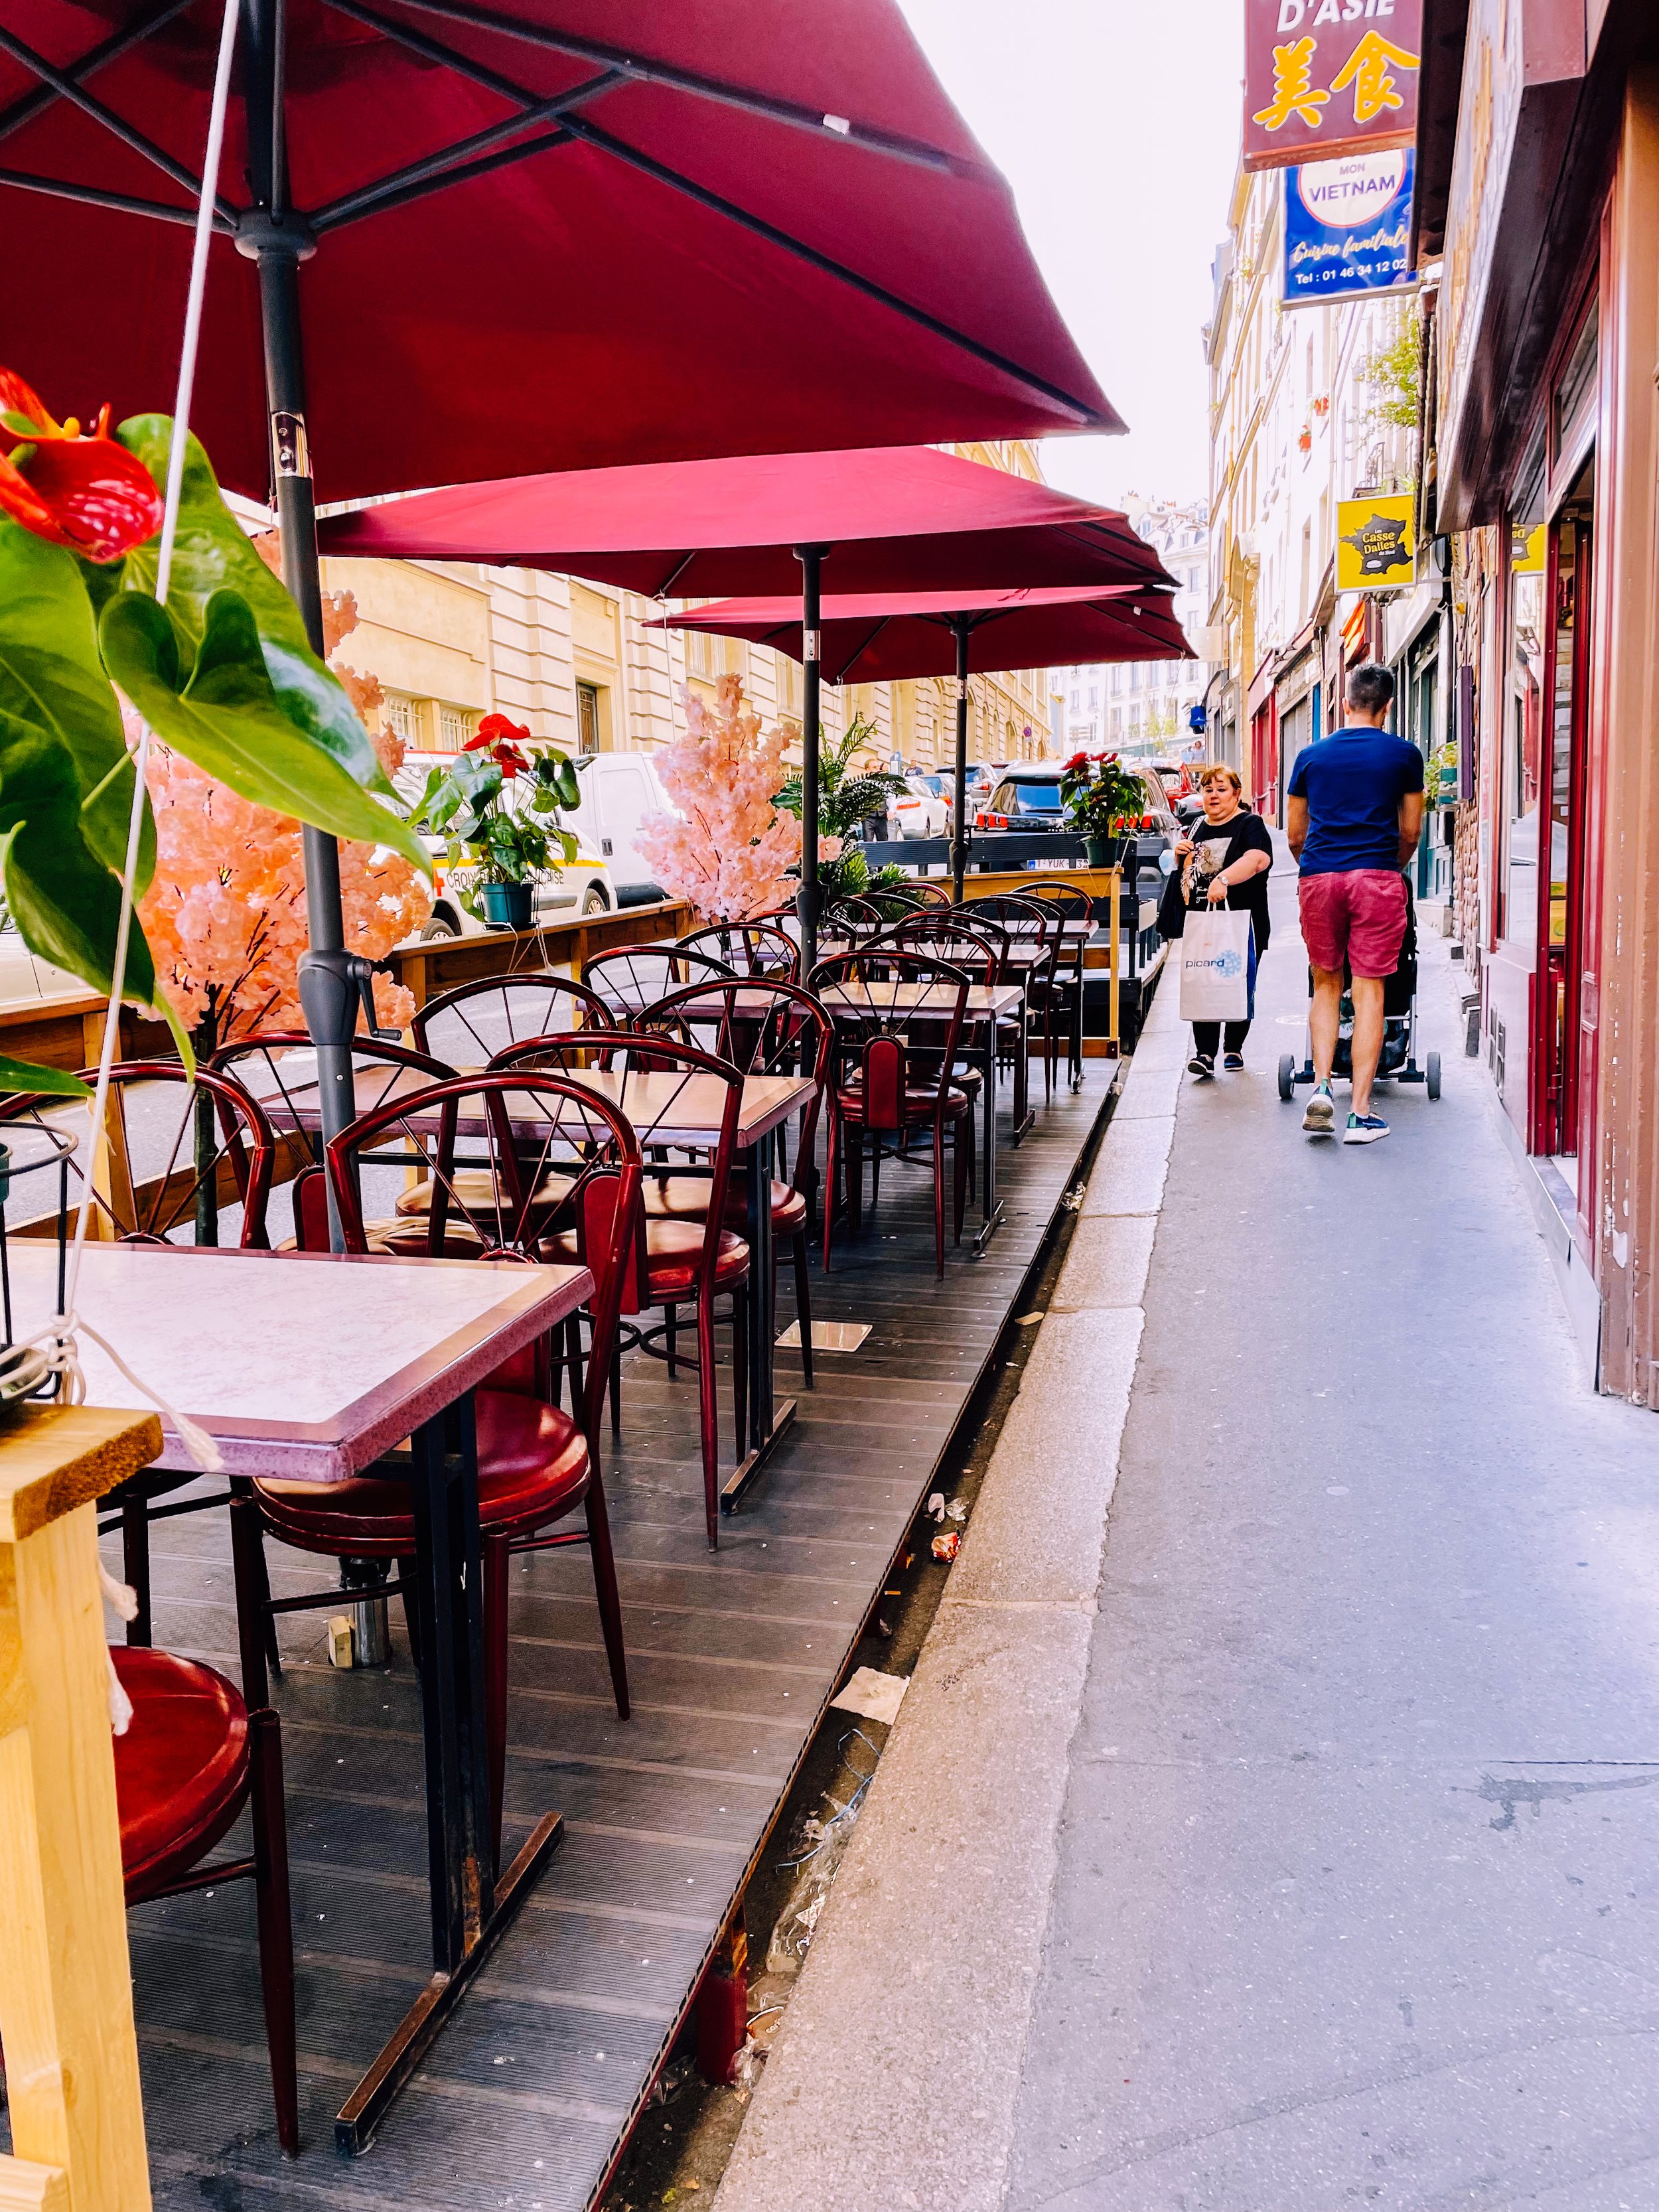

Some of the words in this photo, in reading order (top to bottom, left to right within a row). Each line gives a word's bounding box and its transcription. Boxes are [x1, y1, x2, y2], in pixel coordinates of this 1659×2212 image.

[1252, 29, 1420, 131] 美食
[1339, 163, 1366, 175] MON
[1309, 175, 1396, 202] VIETNAM
[1294, 241, 1340, 263] Cuisine
[1342, 224, 1408, 258] familiale
[1322, 269, 1336, 281] 01
[1340, 266, 1354, 278] 46
[1357, 263, 1372, 276] 34
[1375, 261, 1390, 273] 12
[1392, 258, 1408, 271] 02
[1362, 532, 1396, 544] Casse
[1363, 540, 1396, 555] Dalles
[1185, 958, 1225, 969] picard
